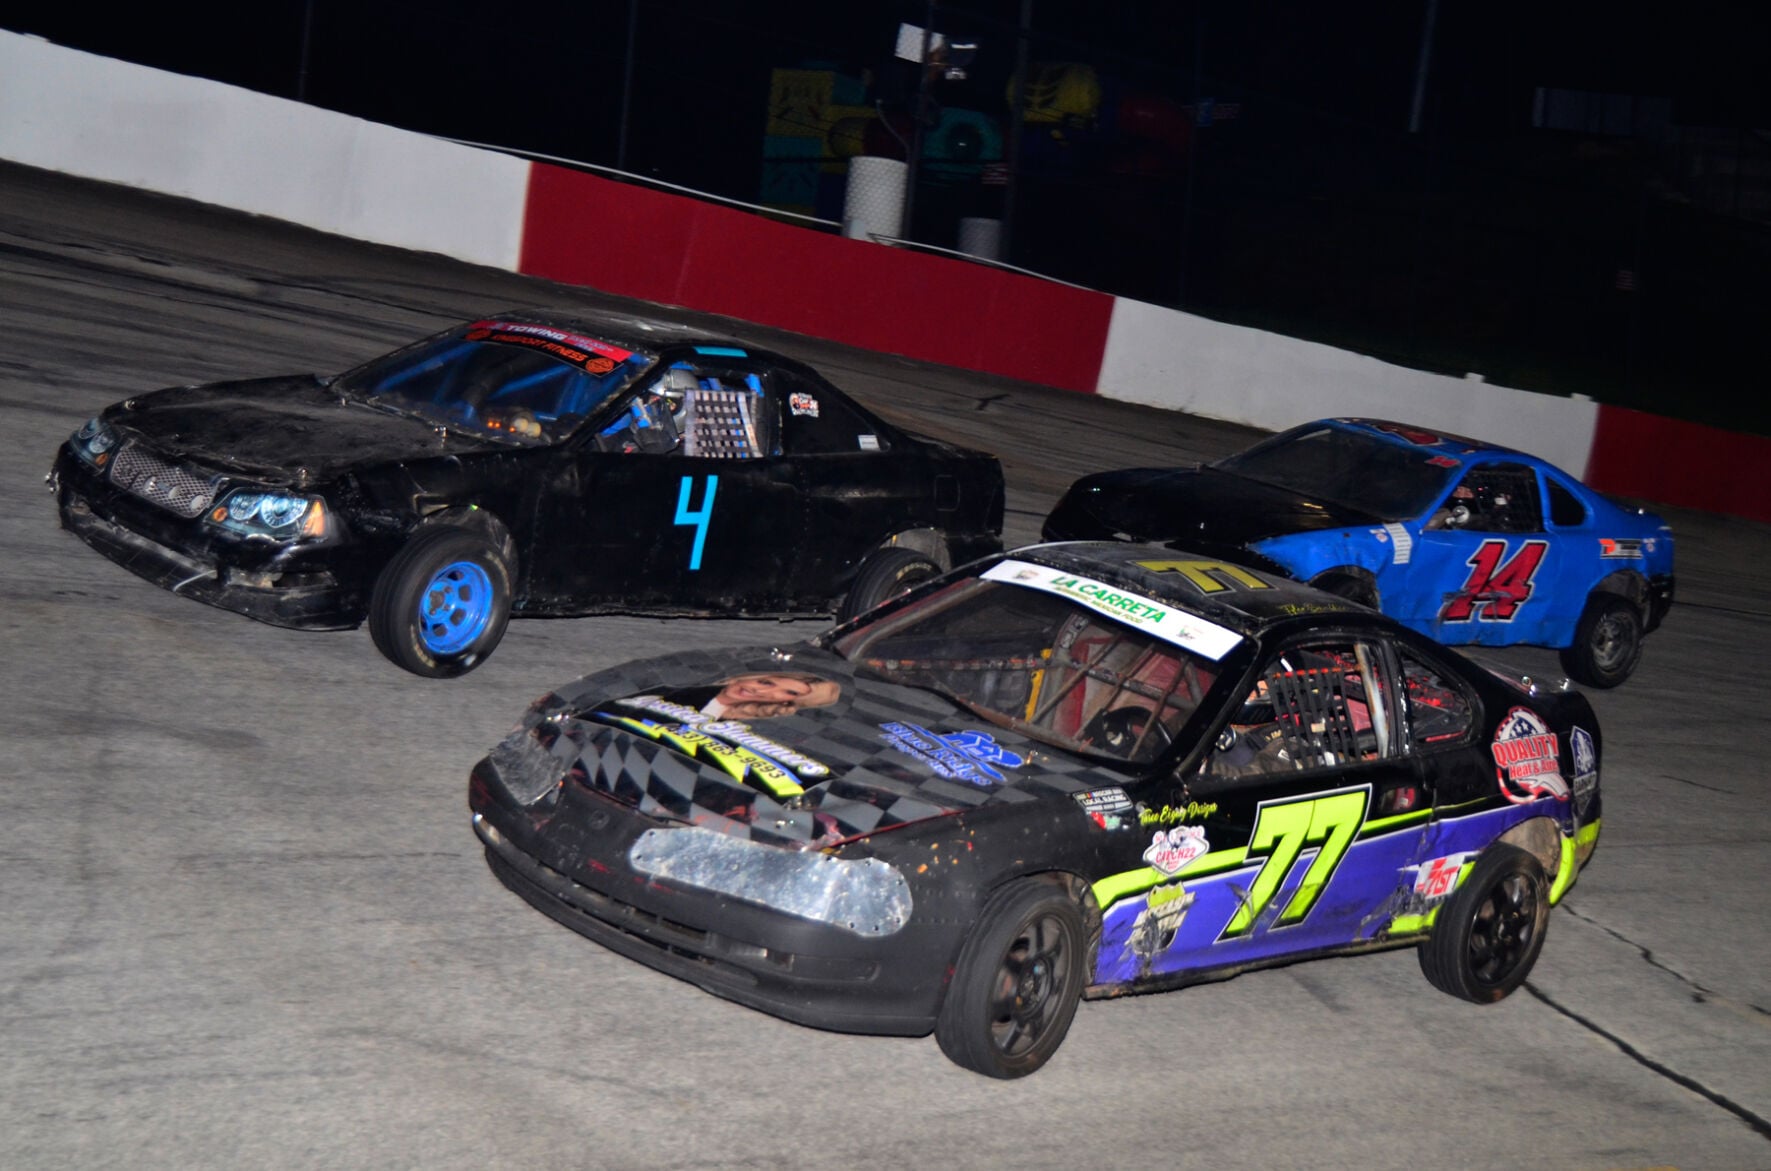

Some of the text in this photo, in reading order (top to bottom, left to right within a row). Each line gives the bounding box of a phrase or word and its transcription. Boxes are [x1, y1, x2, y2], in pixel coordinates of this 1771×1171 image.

[506, 324, 568, 340] TOWING
[542, 341, 589, 362] FITNESS
[674, 475, 718, 570] 4
[1127, 560, 1277, 595] 77
[1439, 539, 1549, 623] 14
[1050, 575, 1167, 624] LA CARRETA
[1121, 611, 1144, 624] FOOD
[1492, 734, 1558, 768] QUALITY
[1509, 762, 1532, 779] Heat
[1187, 801, 1218, 820] Designs
[1216, 785, 1371, 942] 77
